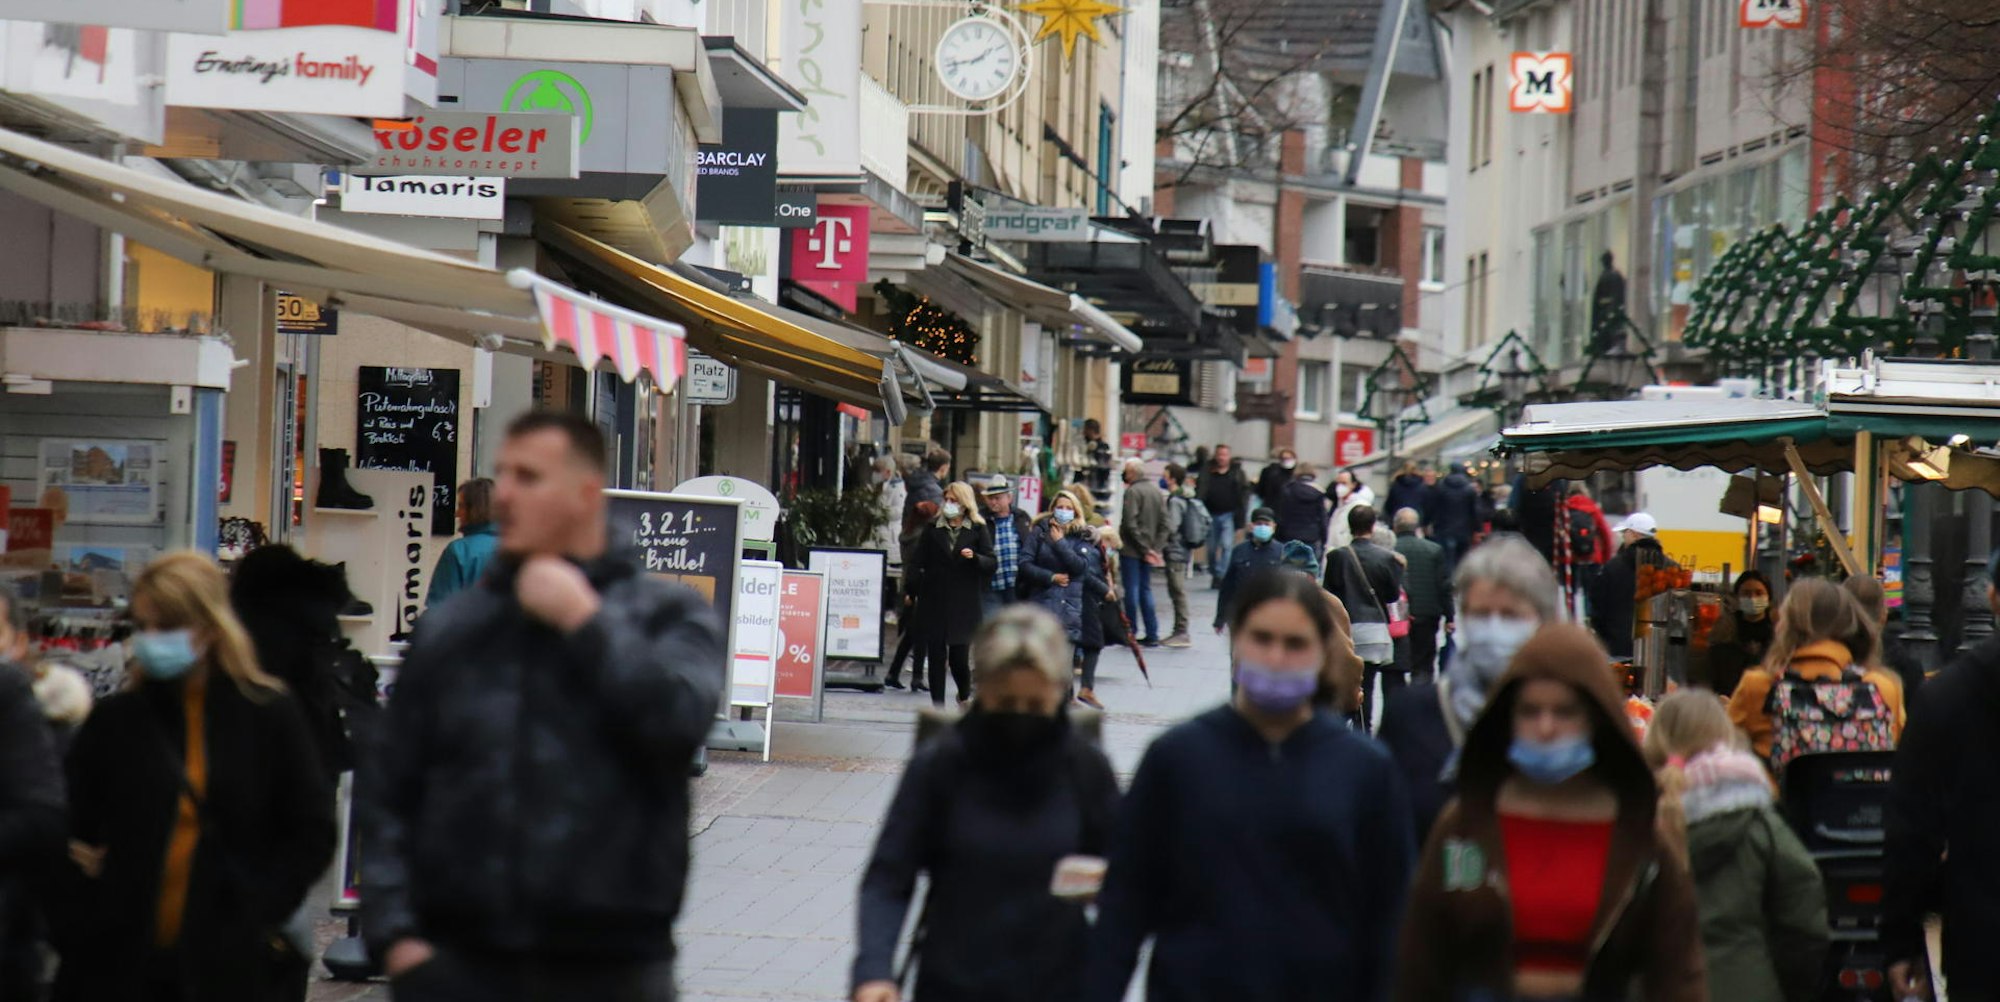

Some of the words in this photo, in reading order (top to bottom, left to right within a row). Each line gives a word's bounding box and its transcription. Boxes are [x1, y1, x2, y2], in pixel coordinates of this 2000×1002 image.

[295, 52, 374, 87] family
[1526, 70, 1553, 94] M
[697, 152, 766, 166] BARCLAY
[708, 168, 739, 176] BRANDS
[779, 203, 811, 216] One
[694, 363, 724, 376] Platz
[653, 537, 689, 547] neue
[646, 548, 705, 572] Brille!
